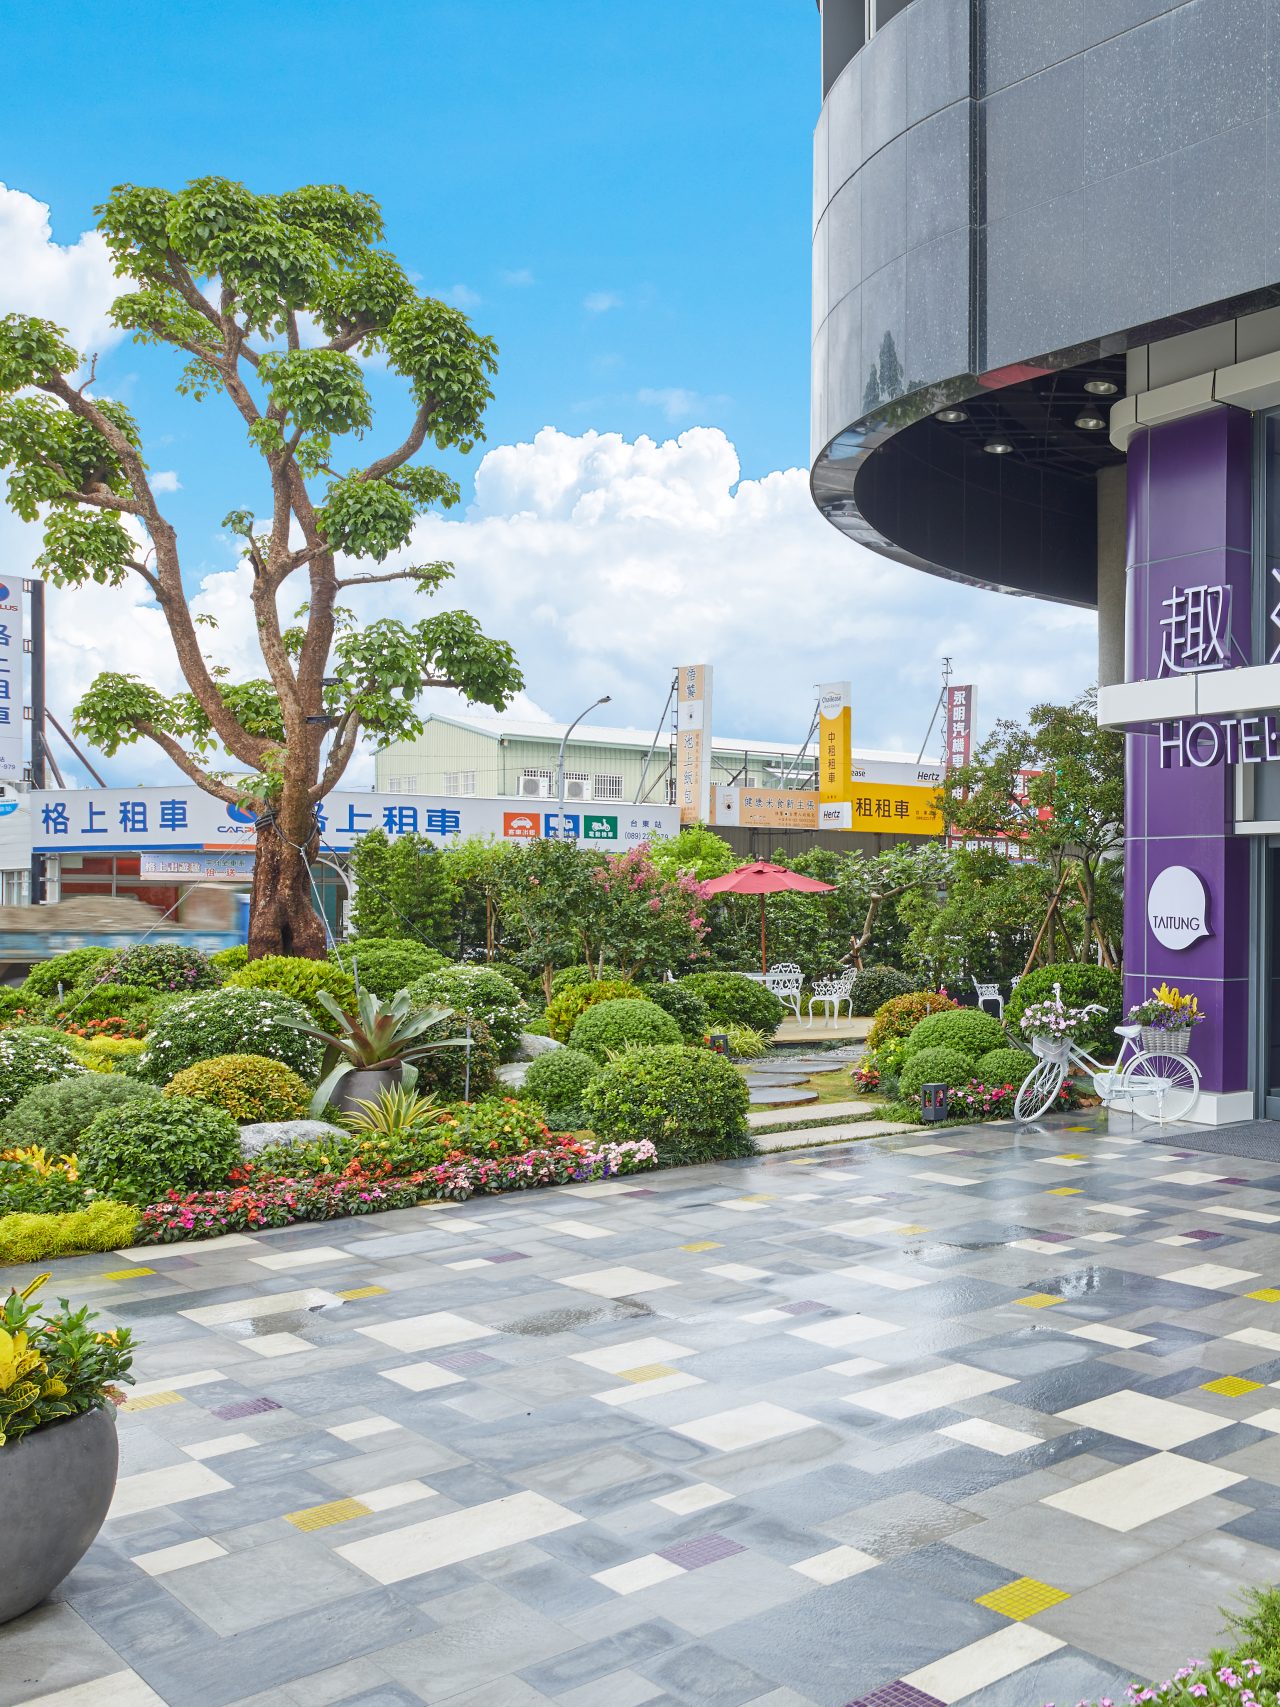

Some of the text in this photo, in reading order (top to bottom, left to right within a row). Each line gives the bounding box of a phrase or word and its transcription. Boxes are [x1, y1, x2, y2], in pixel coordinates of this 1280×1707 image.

[828, 731, 836, 784] 中租租車
[917, 771, 940, 781] Hertz
[42, 798, 188, 835] 格上租車
[823, 810, 841, 819] Hertz
[856, 798, 910, 819] 租租車
[1152, 915, 1200, 931] TAITUNG
